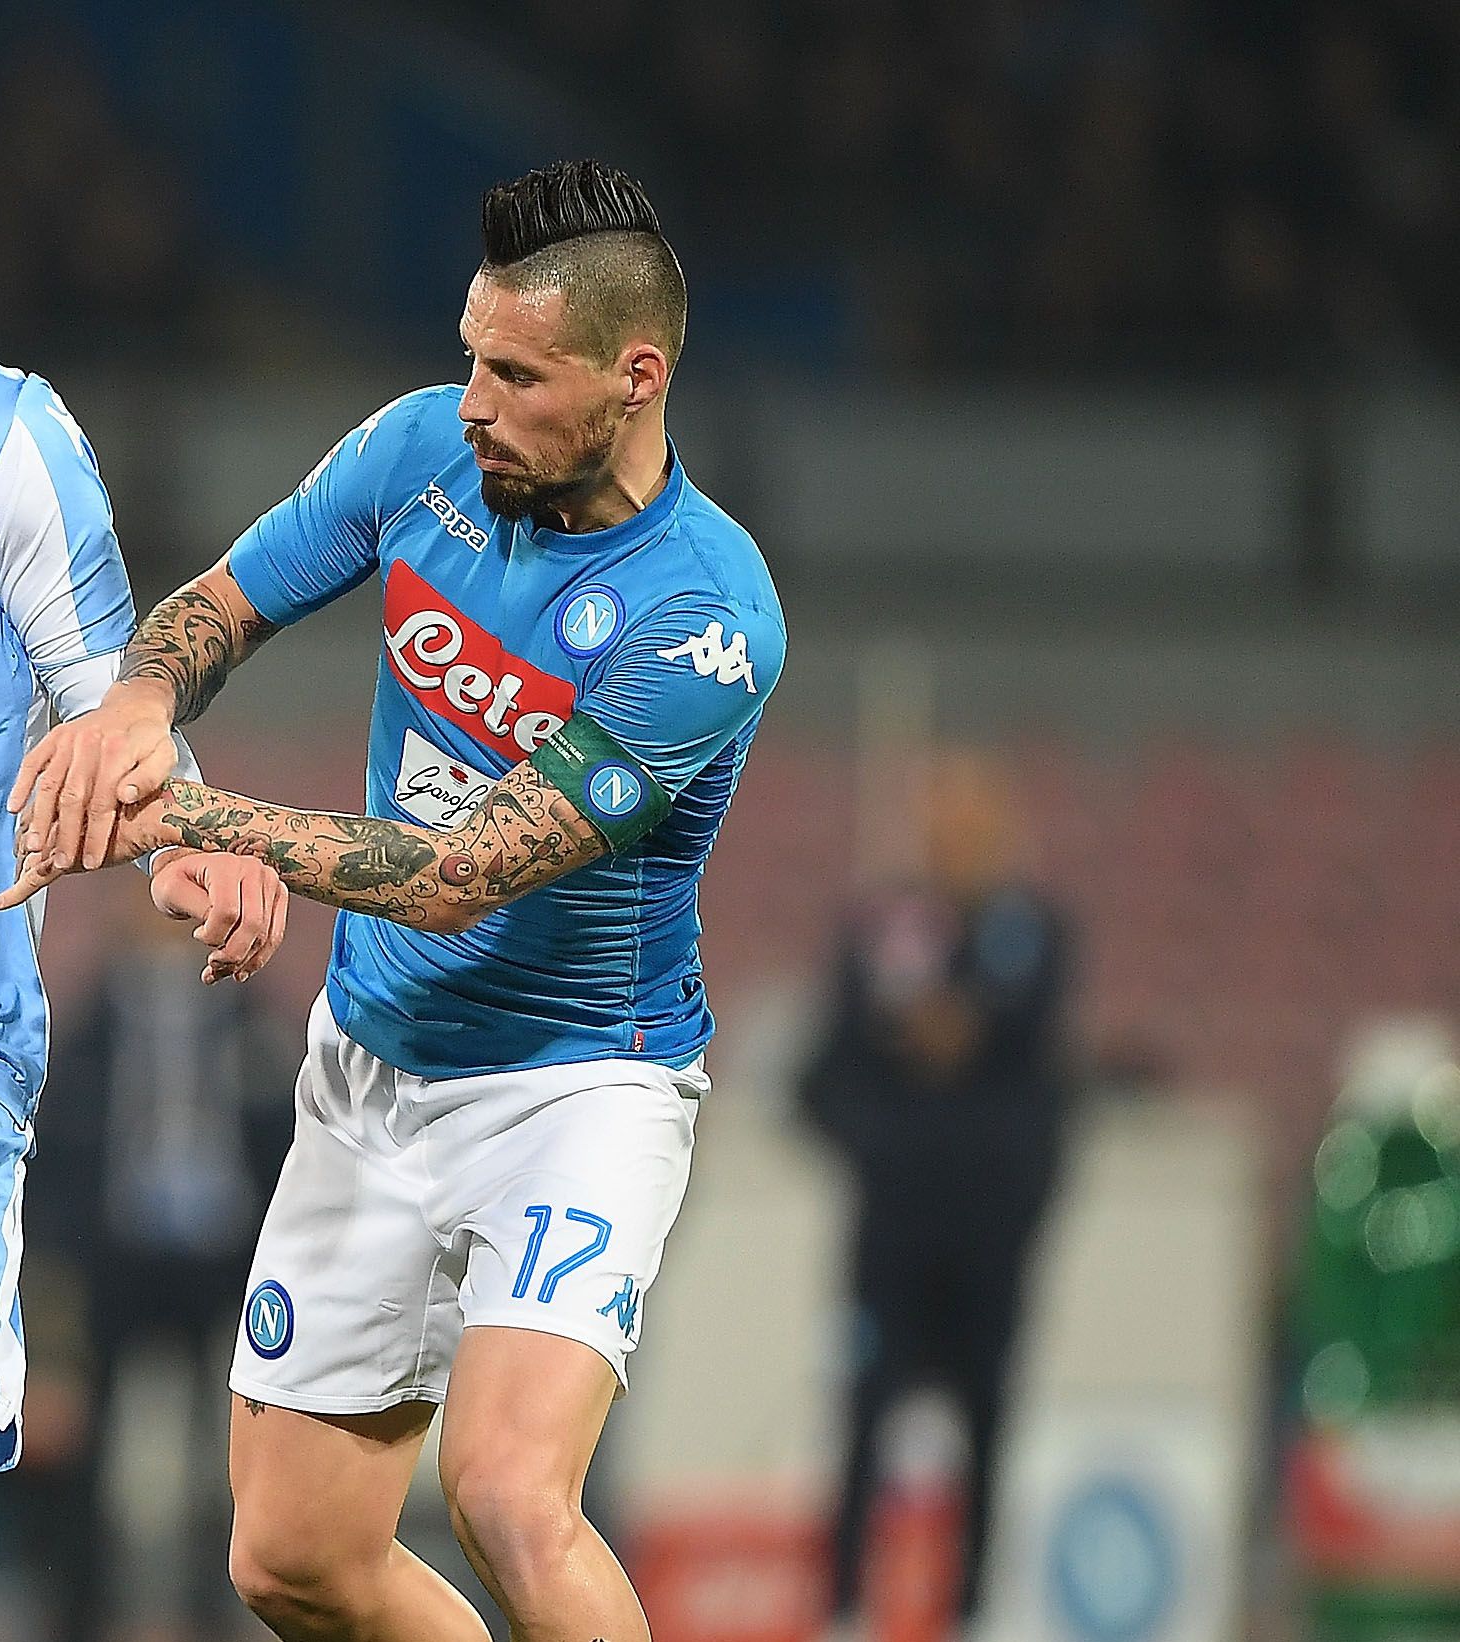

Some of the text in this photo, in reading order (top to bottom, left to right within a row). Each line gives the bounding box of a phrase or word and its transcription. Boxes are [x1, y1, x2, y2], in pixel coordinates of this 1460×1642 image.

[417, 481, 489, 553] Kappa
[383, 609, 566, 755] Lete
[396, 765, 489, 821] Garofa
[511, 1205, 612, 1304] 17
